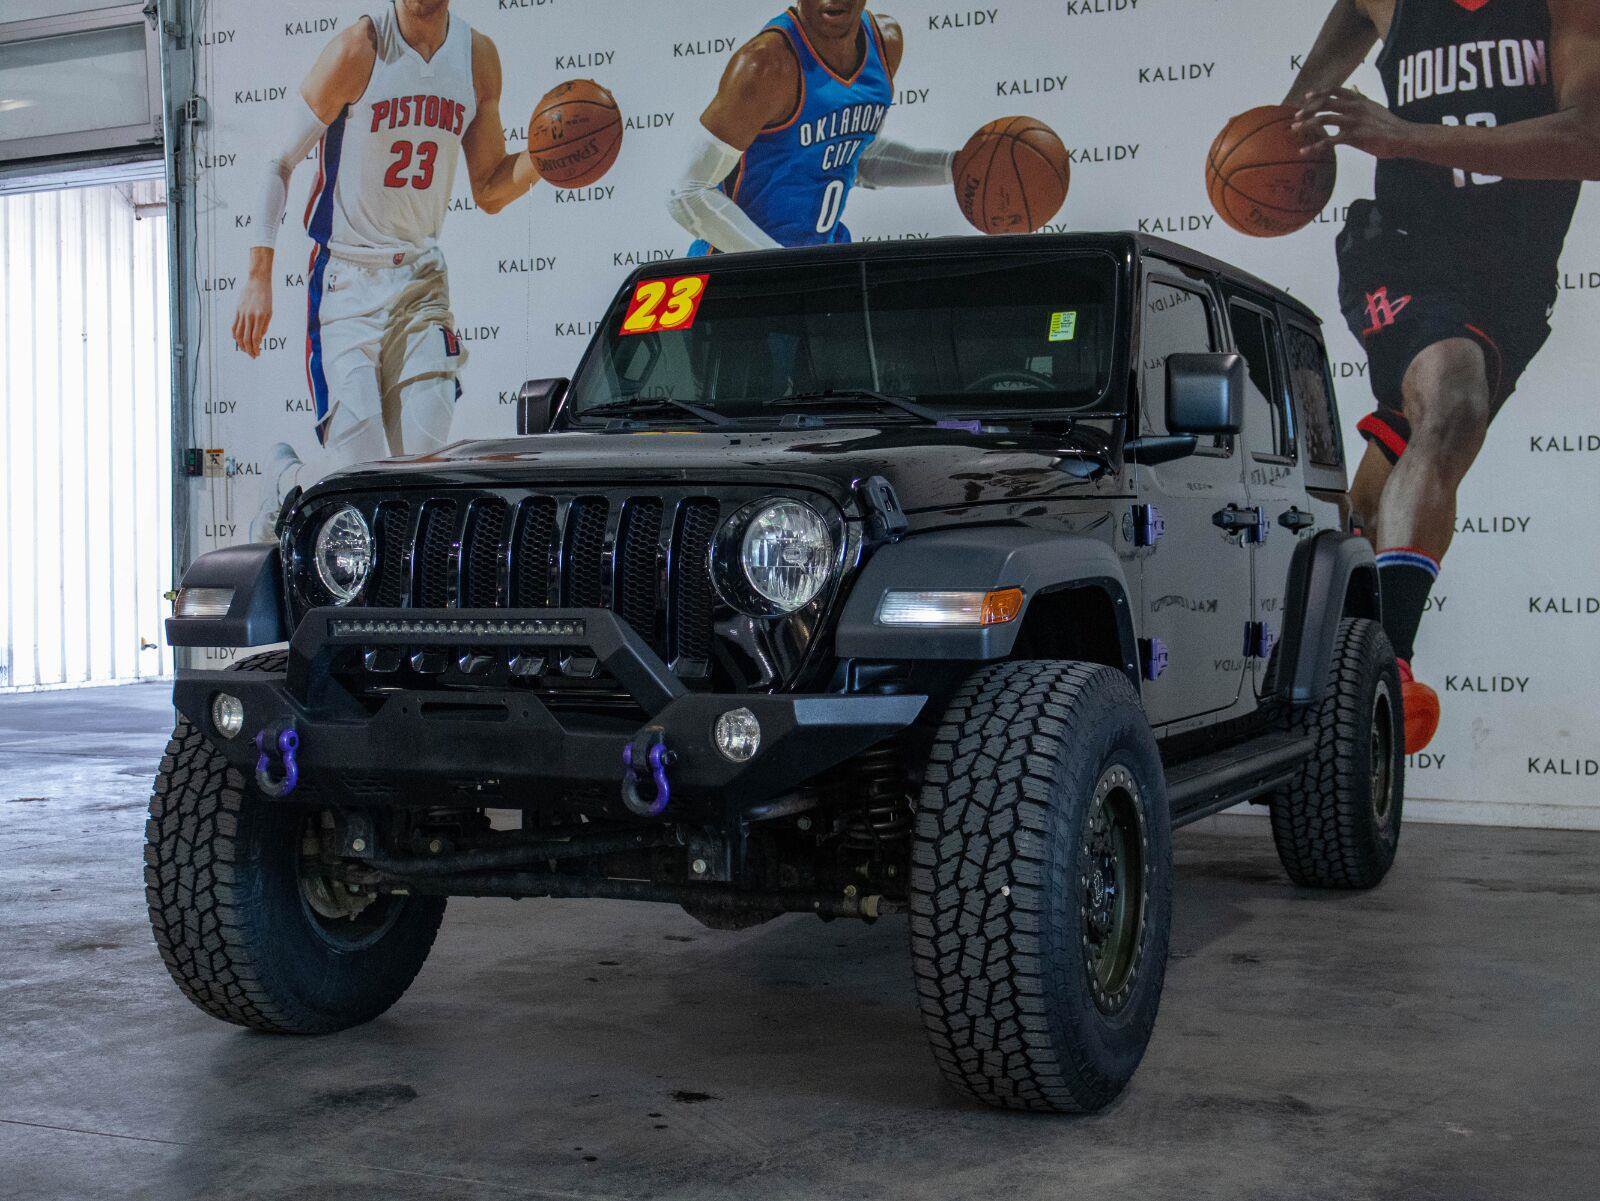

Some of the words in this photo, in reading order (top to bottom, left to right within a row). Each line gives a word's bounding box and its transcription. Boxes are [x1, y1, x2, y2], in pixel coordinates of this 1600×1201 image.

[285, 17, 338, 36] KALIDY
[928, 9, 998, 30] KALIDY
[673, 37, 736, 57] KALIDY
[555, 51, 616, 70] KALIDY
[1138, 62, 1215, 84] KALIDY
[1397, 38, 1548, 107] HOUSTON
[235, 86, 287, 104] KALIDY
[996, 75, 1068, 97] KALIDY
[891, 88, 930, 105] IDY
[370, 94, 466, 136] PISTONS
[821, 139, 862, 171] CITY
[1067, 144, 1140, 164] KALIDY
[383, 140, 439, 190] 23
[555, 186, 616, 204] KALIDY
[816, 180, 845, 233] 0
[1138, 214, 1214, 233] KALIDY
[498, 257, 557, 274] KALIDY
[613, 249, 674, 266] KALIDY
[623, 277, 704, 332] 23
[1445, 675, 1530, 693] KALIDY
[1528, 757, 1599, 776] KALID
